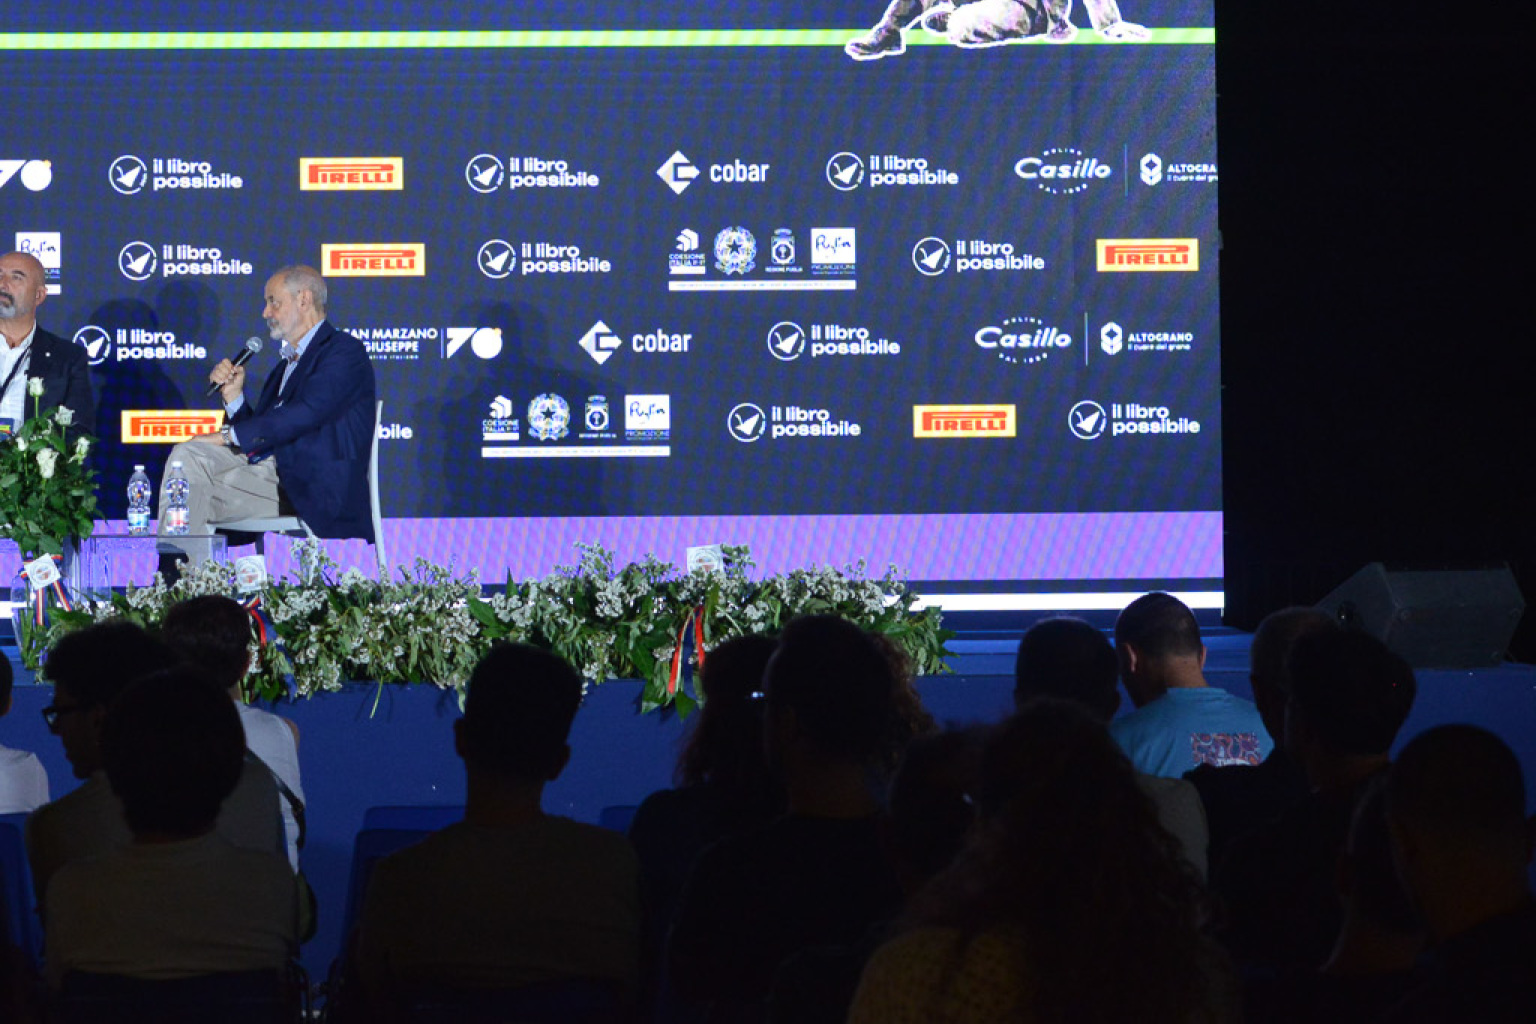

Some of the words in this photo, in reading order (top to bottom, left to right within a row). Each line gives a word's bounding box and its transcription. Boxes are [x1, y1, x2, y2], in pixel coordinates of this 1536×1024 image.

[152, 158, 163, 174] il
[166, 158, 211, 174] libro
[509, 156, 520, 172] il
[523, 156, 568, 172] libro
[709, 159, 770, 183] cobar
[869, 154, 880, 170] il
[883, 154, 928, 170] libro
[1014, 156, 1113, 179] Casillo
[1166, 163, 1218, 174] ALTOGRA
[152, 173, 243, 191] possibile
[308, 162, 395, 184] PIRELLI
[509, 171, 600, 189] possibile
[869, 169, 960, 187] possibile
[162, 243, 173, 259] il
[176, 243, 221, 259] libro
[520, 241, 531, 257] il
[534, 241, 579, 257] libro
[955, 239, 966, 255] il
[969, 239, 1014, 255] libro
[1104, 244, 1190, 265] PIRELLI
[162, 258, 253, 276] possibile
[329, 249, 416, 270] PIRELLI
[520, 256, 611, 274] possibile
[955, 254, 1046, 272] possibile
[116, 328, 127, 344] il
[130, 328, 175, 344] libro
[371, 327, 439, 340] MARZANO
[810, 324, 821, 340] il
[824, 324, 869, 340] libro
[974, 326, 1072, 349] Casillo
[1127, 331, 1194, 343] ALTOGRANO
[632, 330, 692, 353] cobar
[810, 339, 901, 357] possibile
[116, 343, 207, 361] possibile
[771, 405, 782, 421] il
[785, 405, 830, 421] libro
[1111, 402, 1122, 418] il
[1125, 402, 1170, 418] libro
[130, 416, 217, 438] PIRELLI
[771, 420, 862, 438] possibile
[921, 410, 1008, 431] PIRELLI
[1111, 417, 1202, 435] possibile
